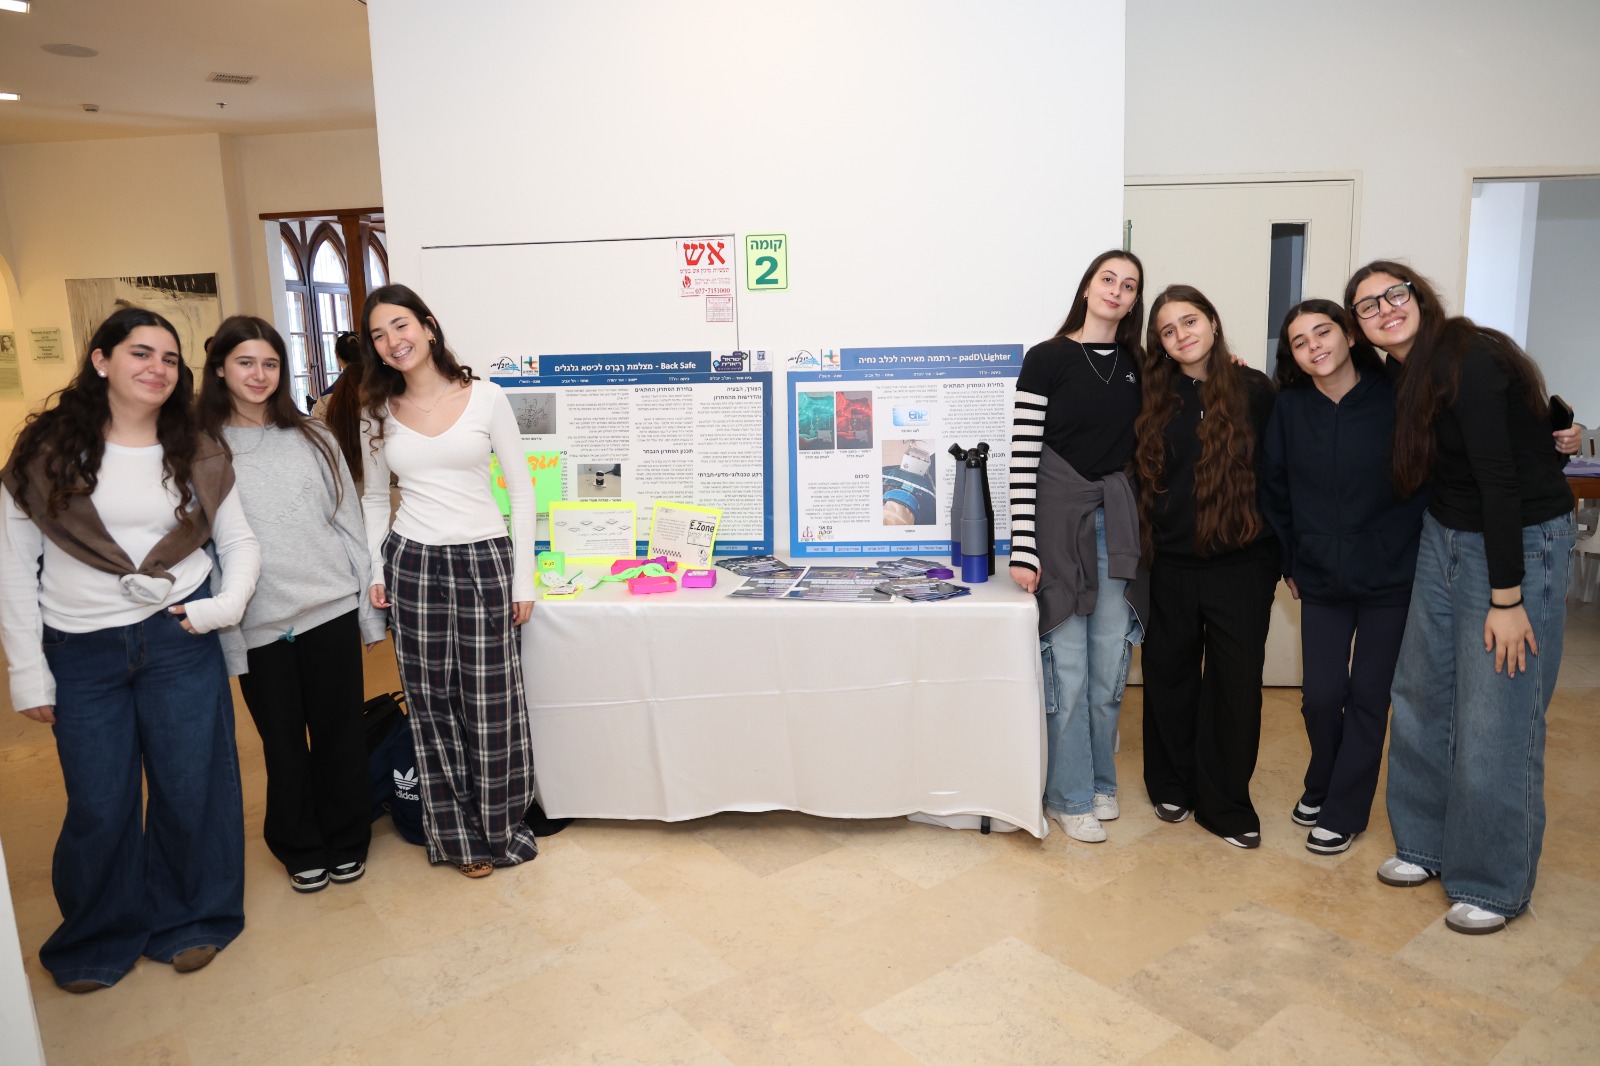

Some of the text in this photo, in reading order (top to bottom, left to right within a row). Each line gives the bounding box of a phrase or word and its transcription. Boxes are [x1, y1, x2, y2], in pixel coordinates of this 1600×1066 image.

[750, 239, 783, 253] קומה
[683, 241, 726, 266] אש
[755, 255, 779, 285] 2
[858, 355, 877, 364] נחיה
[878, 354, 899, 364] לכלב
[900, 355, 925, 363] מאירה
[554, 363, 580, 372] גלגלים
[580, 362, 603, 372] לכיסא
[626, 362, 654, 370] מצלמת
[660, 361, 679, 370] Back
[680, 361, 697, 370] Safe
[690, 520, 715, 533] E.Zone
